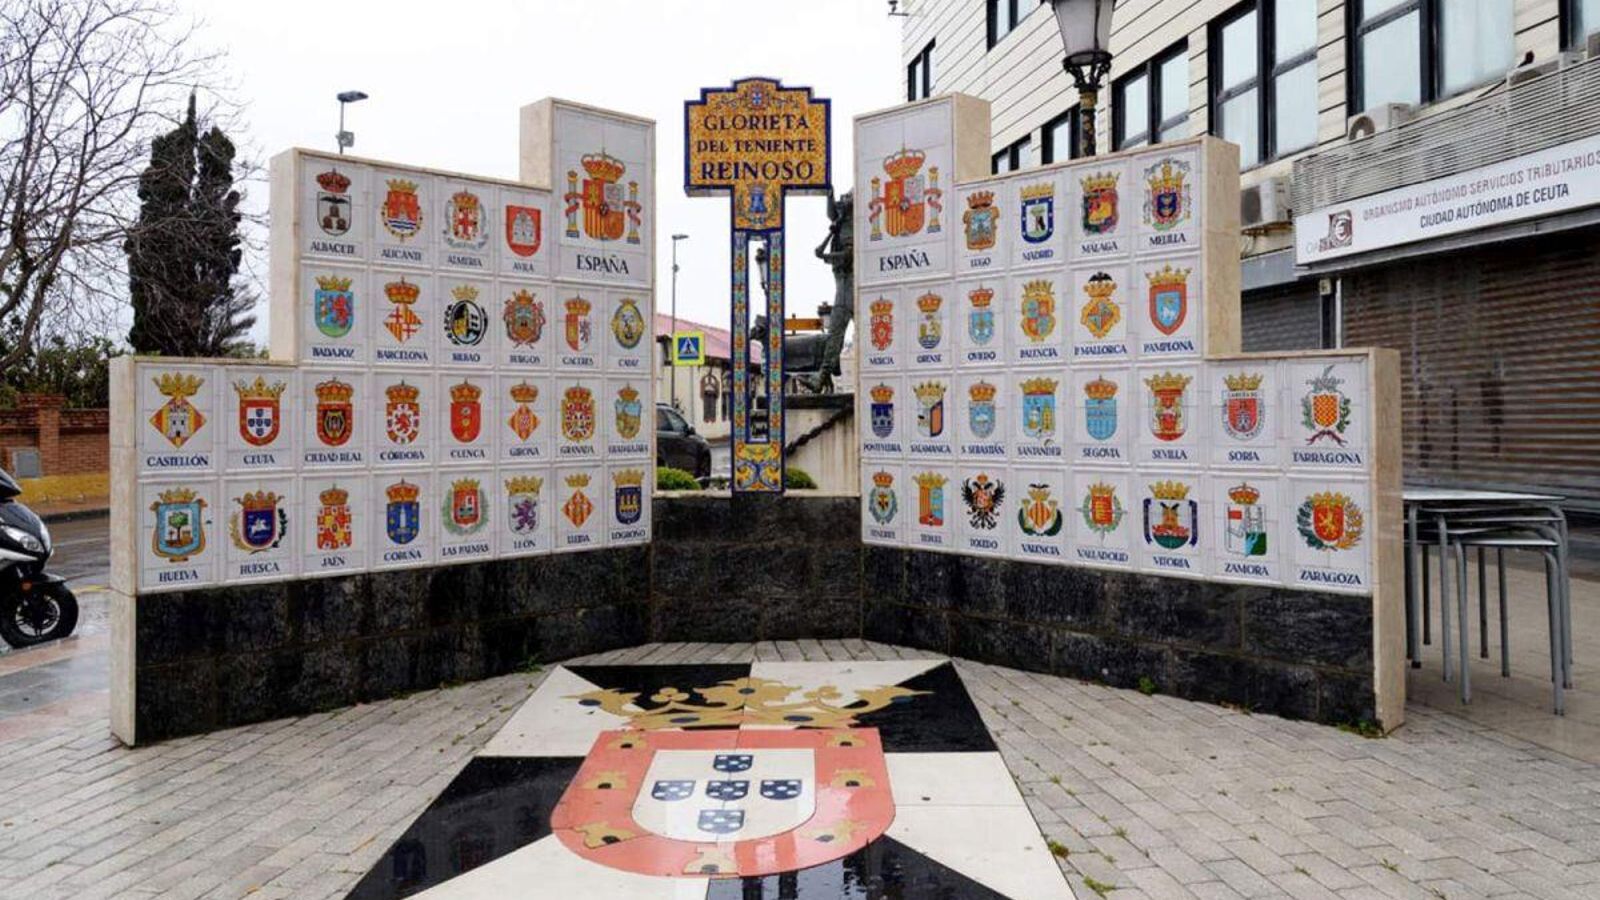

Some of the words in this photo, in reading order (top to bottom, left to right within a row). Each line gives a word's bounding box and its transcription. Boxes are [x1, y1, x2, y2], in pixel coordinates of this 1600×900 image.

[703, 113, 809, 131] GLORIETA
[696, 139, 729, 153] DEL
[733, 139, 816, 153] TENIENTE
[702, 160, 814, 180] REINOSO
[1363, 198, 1413, 221] ORGANISMO
[1469, 170, 1524, 196] SERVICIOS
[1526, 150, 1600, 182] TRIBUTARIOS
[1420, 208, 1454, 229] CIUDAD
[1515, 190, 1530, 208] DE
[1533, 183, 1569, 204] CEUTA
[1150, 234, 1187, 246] MELILLA
[381, 249, 422, 261] ALICANTE
[1022, 250, 1054, 261] MADRID
[576, 254, 629, 275] ESPAÑA
[879, 250, 931, 273] ESPAÑA
[970, 257, 991, 268] LUGO
[312, 346, 355, 359] BADAJOZ
[1143, 341, 1194, 353] PAMPLONA
[377, 350, 429, 361] BARCELONA
[452, 352, 481, 363] BILBAO
[917, 354, 943, 364] ORENSE
[967, 351, 997, 360] OVIEDO
[1020, 348, 1058, 359] PALENCIA
[450, 448, 486, 459] CUENCA
[560, 445, 595, 454] GRANADA
[910, 442, 952, 454] SALAMANCA
[1017, 446, 1062, 457] SANTANDER
[1082, 447, 1121, 458] SEGOVIA
[243, 454, 275, 465] CEUTA
[304, 452, 339, 463] CIUDAD
[340, 451, 362, 462] REAL
[1152, 449, 1188, 460] SEVILLA
[1228, 450, 1260, 462] SORIA
[1293, 452, 1361, 464] TARRAGONA
[441, 547, 457, 556] LAS
[458, 543, 489, 555] PALMAS
[970, 538, 998, 549] TOLEDO
[1021, 543, 1060, 556] VALENCIA
[1077, 549, 1129, 562] VALLADOLID
[240, 562, 280, 575] HUESCA
[1152, 556, 1190, 569] VITORIA
[1224, 563, 1269, 576] ZAMORA
[159, 569, 198, 583] HUELVA
[1300, 570, 1362, 585] ZARAGOZA
